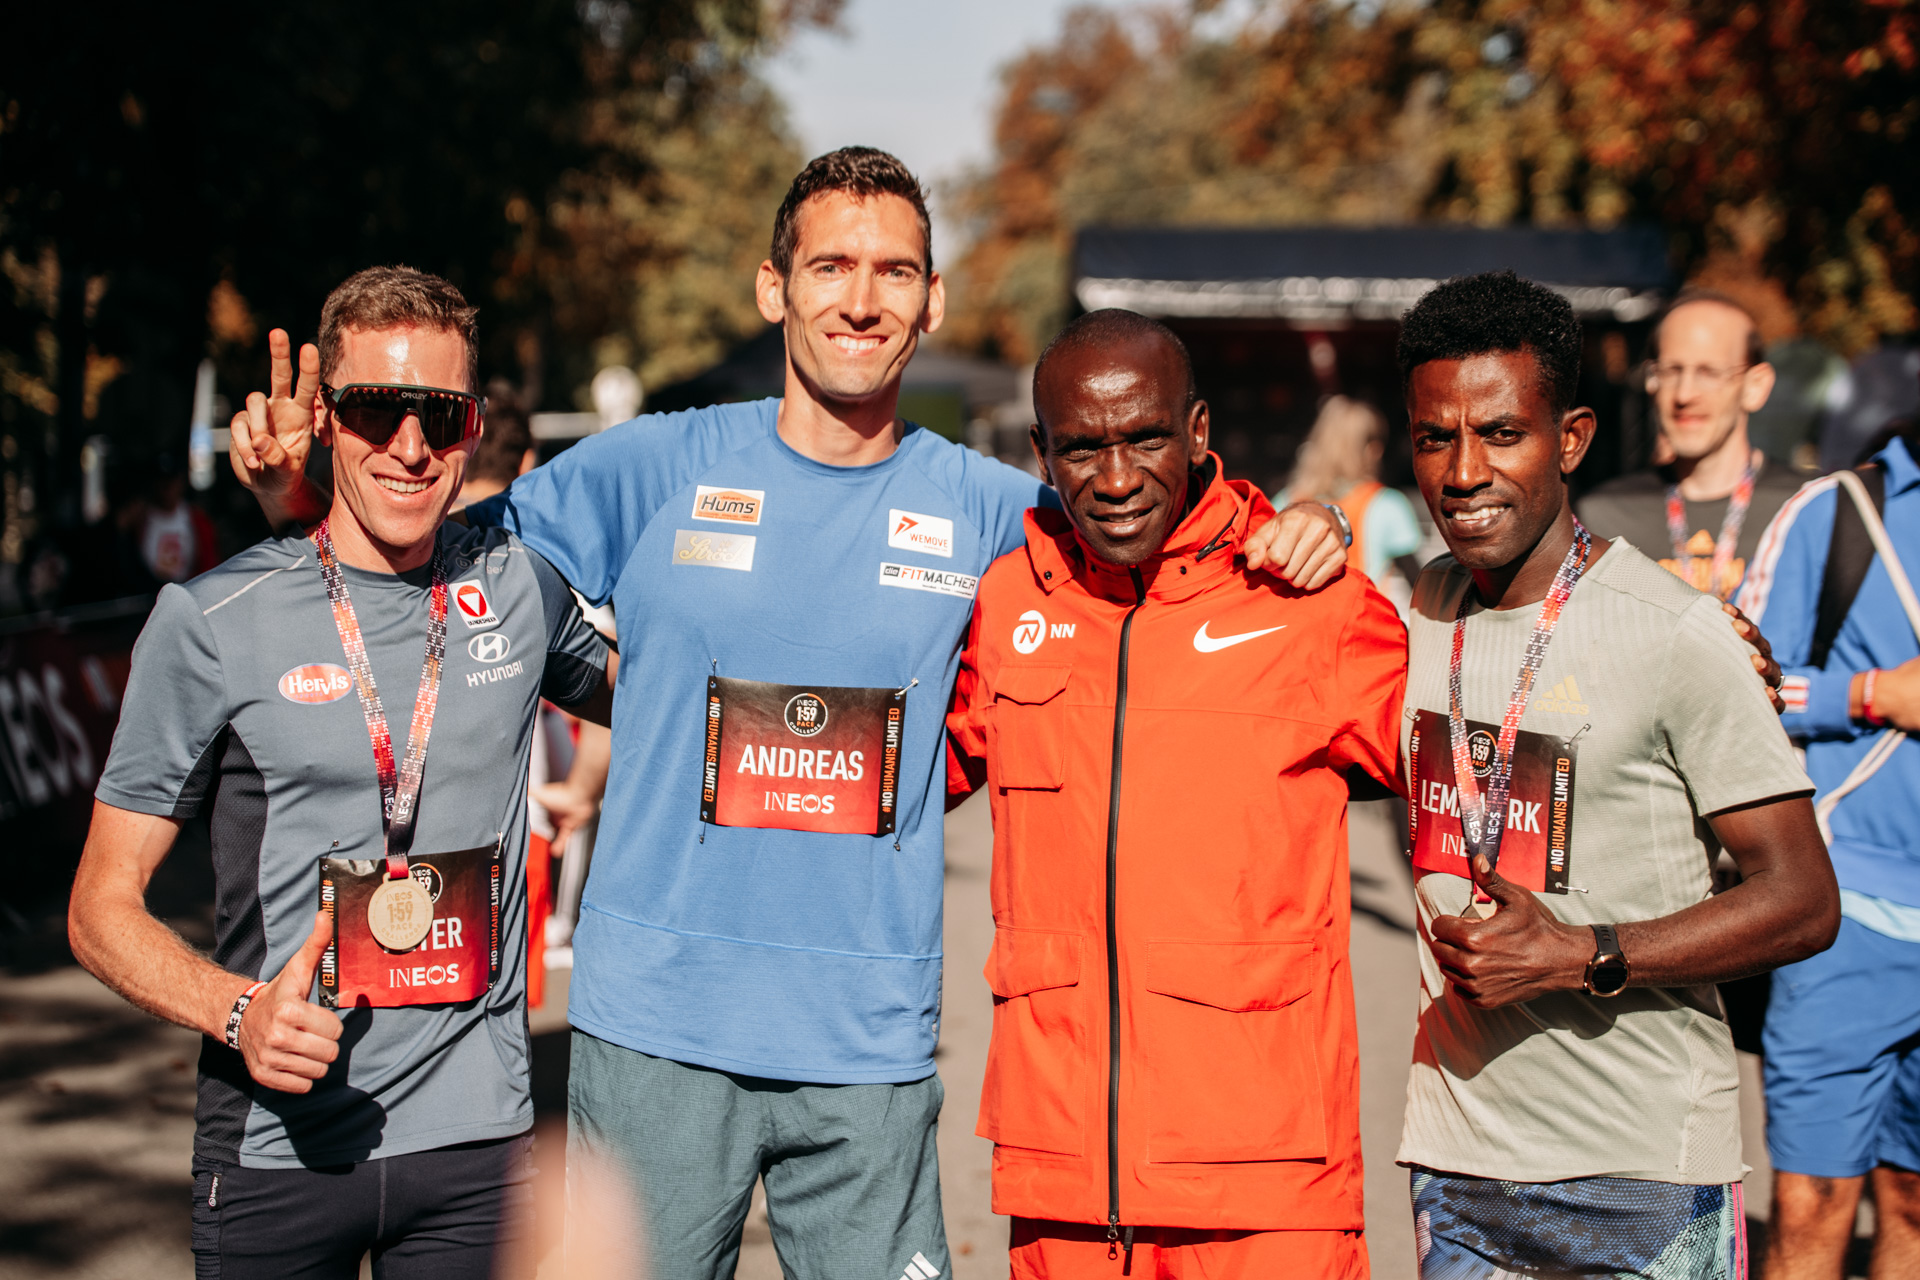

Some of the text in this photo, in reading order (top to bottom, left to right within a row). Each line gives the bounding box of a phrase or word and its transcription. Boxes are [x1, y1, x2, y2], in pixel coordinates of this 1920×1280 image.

[701, 496, 756, 514] Hums
[910, 533, 948, 548] WEMOVE
[902, 568, 976, 590] FITMACHER
[1050, 624, 1076, 638] NN
[288, 673, 348, 695] Hervis
[466, 660, 524, 688] HYUNDAI
[796, 706, 817, 722] 1:59
[1534, 698, 1590, 716] adidas
[790, 722, 821, 734] CHALLENGE
[704, 696, 720, 802] #NOHUMANISLIMITED
[1473, 736, 1490, 746] INEOS
[737, 744, 864, 781] ANDREAS
[882, 708, 900, 812] #NOHUMANISLIMITED
[1410, 730, 1420, 840] #NOHUMANISLIMITED
[396, 794, 412, 824] INEOS
[764, 791, 835, 814] INEOS
[1550, 758, 1570, 872] #NOHUMANISLIMITED
[1468, 811, 1482, 844] INEOS
[1486, 812, 1501, 844] INEOS
[386, 891, 412, 902] INEOS
[387, 901, 413, 923] 1:59
[490, 864, 500, 971] #NOHUMANISLIMITED
[391, 922, 412, 932] PACE
[389, 963, 460, 988] INEOS
